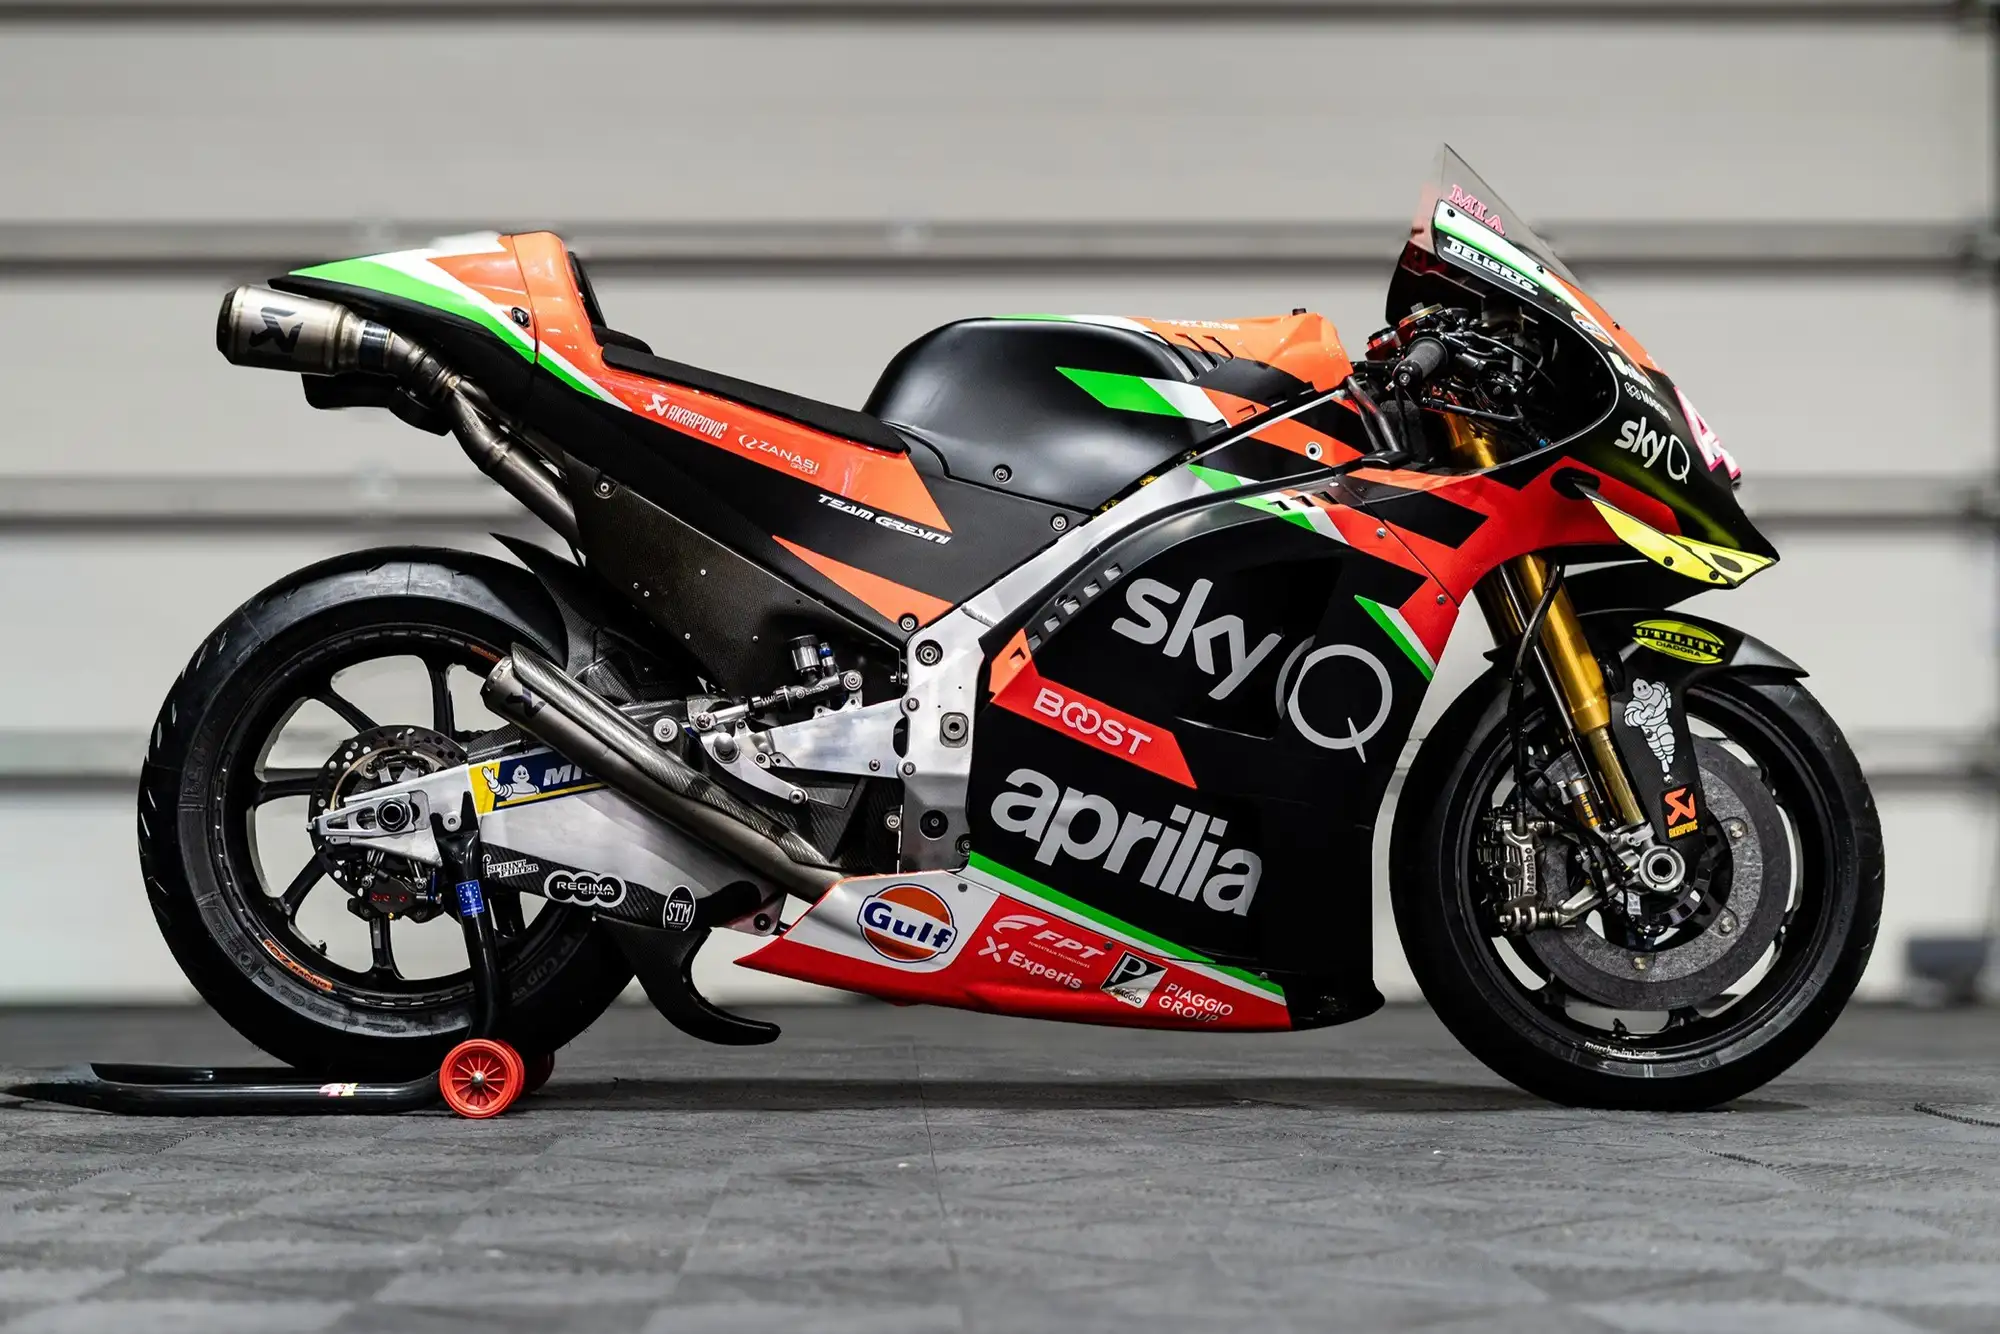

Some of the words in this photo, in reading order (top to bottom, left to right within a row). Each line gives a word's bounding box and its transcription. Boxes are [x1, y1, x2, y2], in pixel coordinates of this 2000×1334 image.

[1448, 184, 1505, 237] MIA
[666, 405, 728, 439] AKRAPOVIČ
[758, 440, 820, 472] ZANASI
[1613, 416, 1667, 468] sky
[1667, 434, 1691, 484] Q
[790, 462, 817, 475] GROUP
[818, 494, 874, 520] TEAM
[875, 516, 951, 544] GRESINI
[1635, 628, 1722, 655] UTILITY
[1656, 641, 1702, 658] DIADORA
[1111, 578, 1283, 700] sky
[1275, 635, 1393, 763] Q
[1033, 688, 1152, 755] BOOST
[990, 768, 1262, 916] aprilia
[488, 859, 527, 874] SPRINT
[499, 863, 539, 878] FILTER
[1524, 847, 1536, 895] brembo
[556, 881, 615, 895] REGINA
[666, 902, 693, 923] STM
[863, 901, 953, 949] Gulf
[1033, 930, 1106, 959] FPT
[292, 964, 331, 990] RACING
[1008, 950, 1083, 989] Experis
[1159, 995, 1219, 1023] GROUP
[1164, 983, 1234, 1016] PIAGGIO
